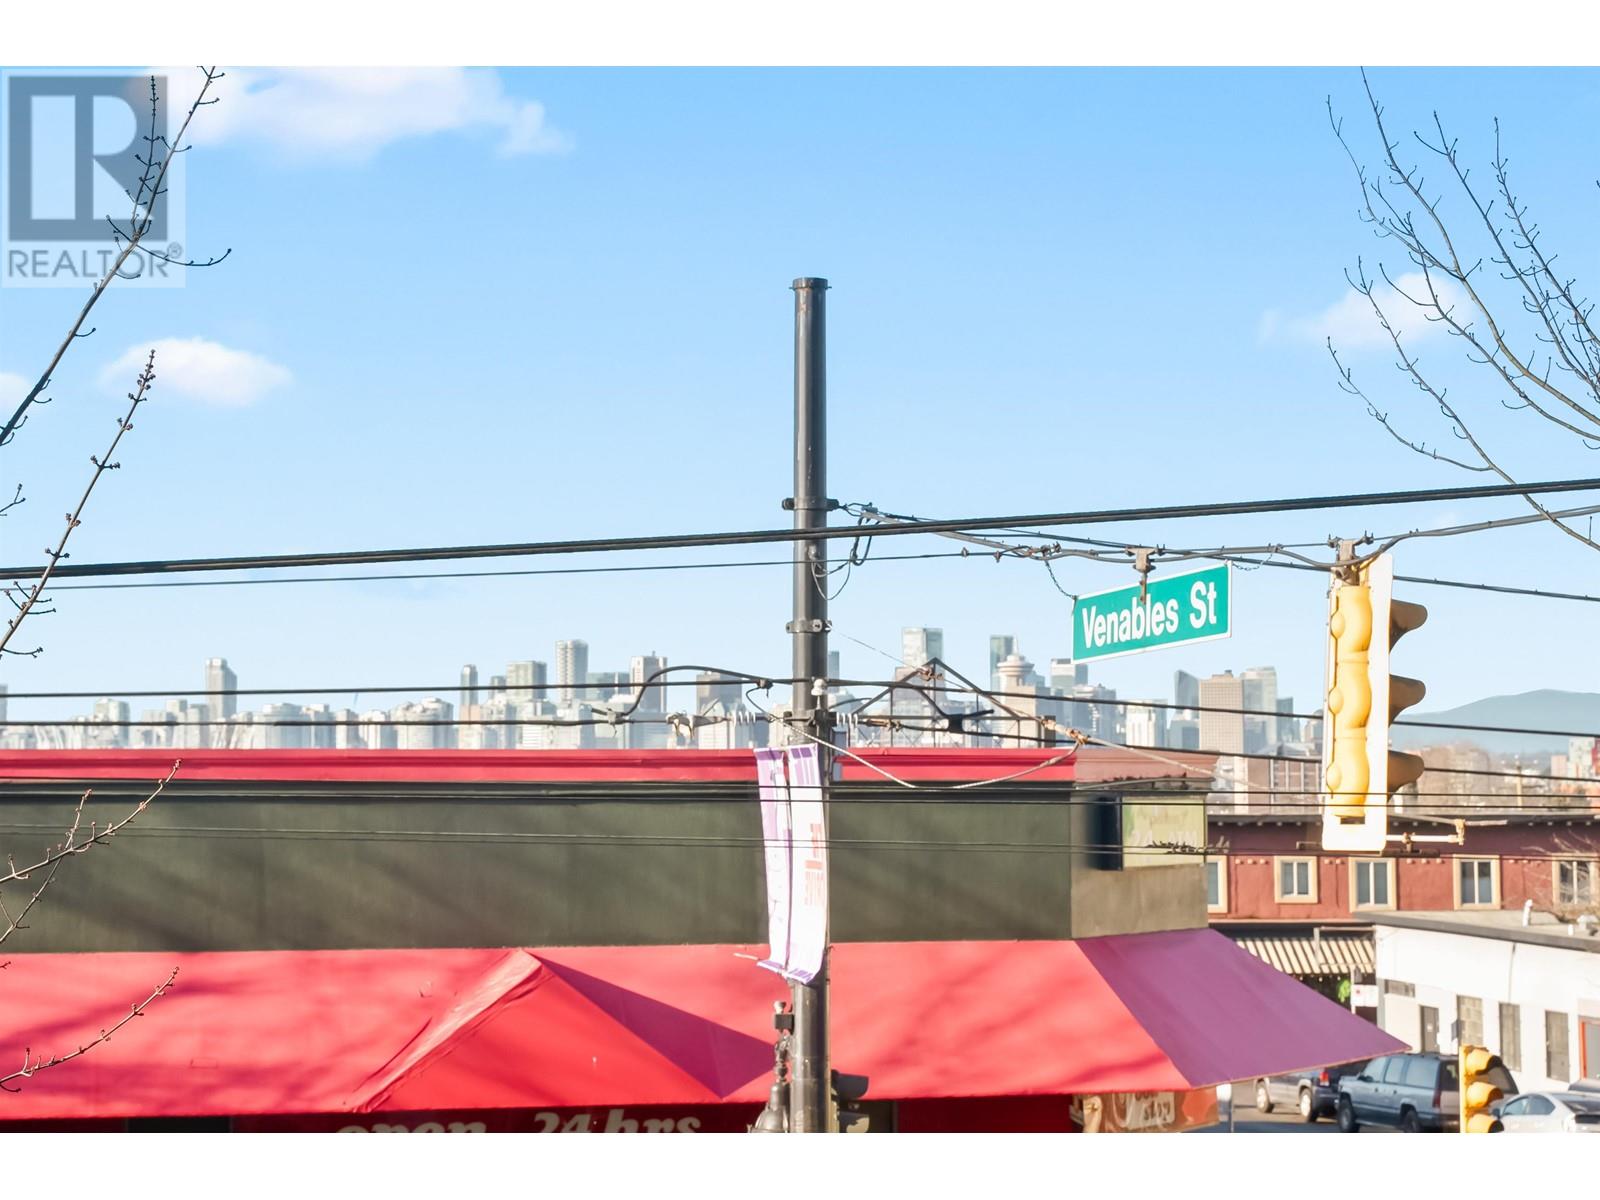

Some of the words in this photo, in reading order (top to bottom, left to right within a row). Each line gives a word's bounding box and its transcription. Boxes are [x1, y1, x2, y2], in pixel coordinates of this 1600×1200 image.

[1082, 593, 1179, 648] Venables
[1189, 581, 1217, 628] St
[534, 1112, 592, 1133] 24
[604, 1109, 701, 1133] hrs
